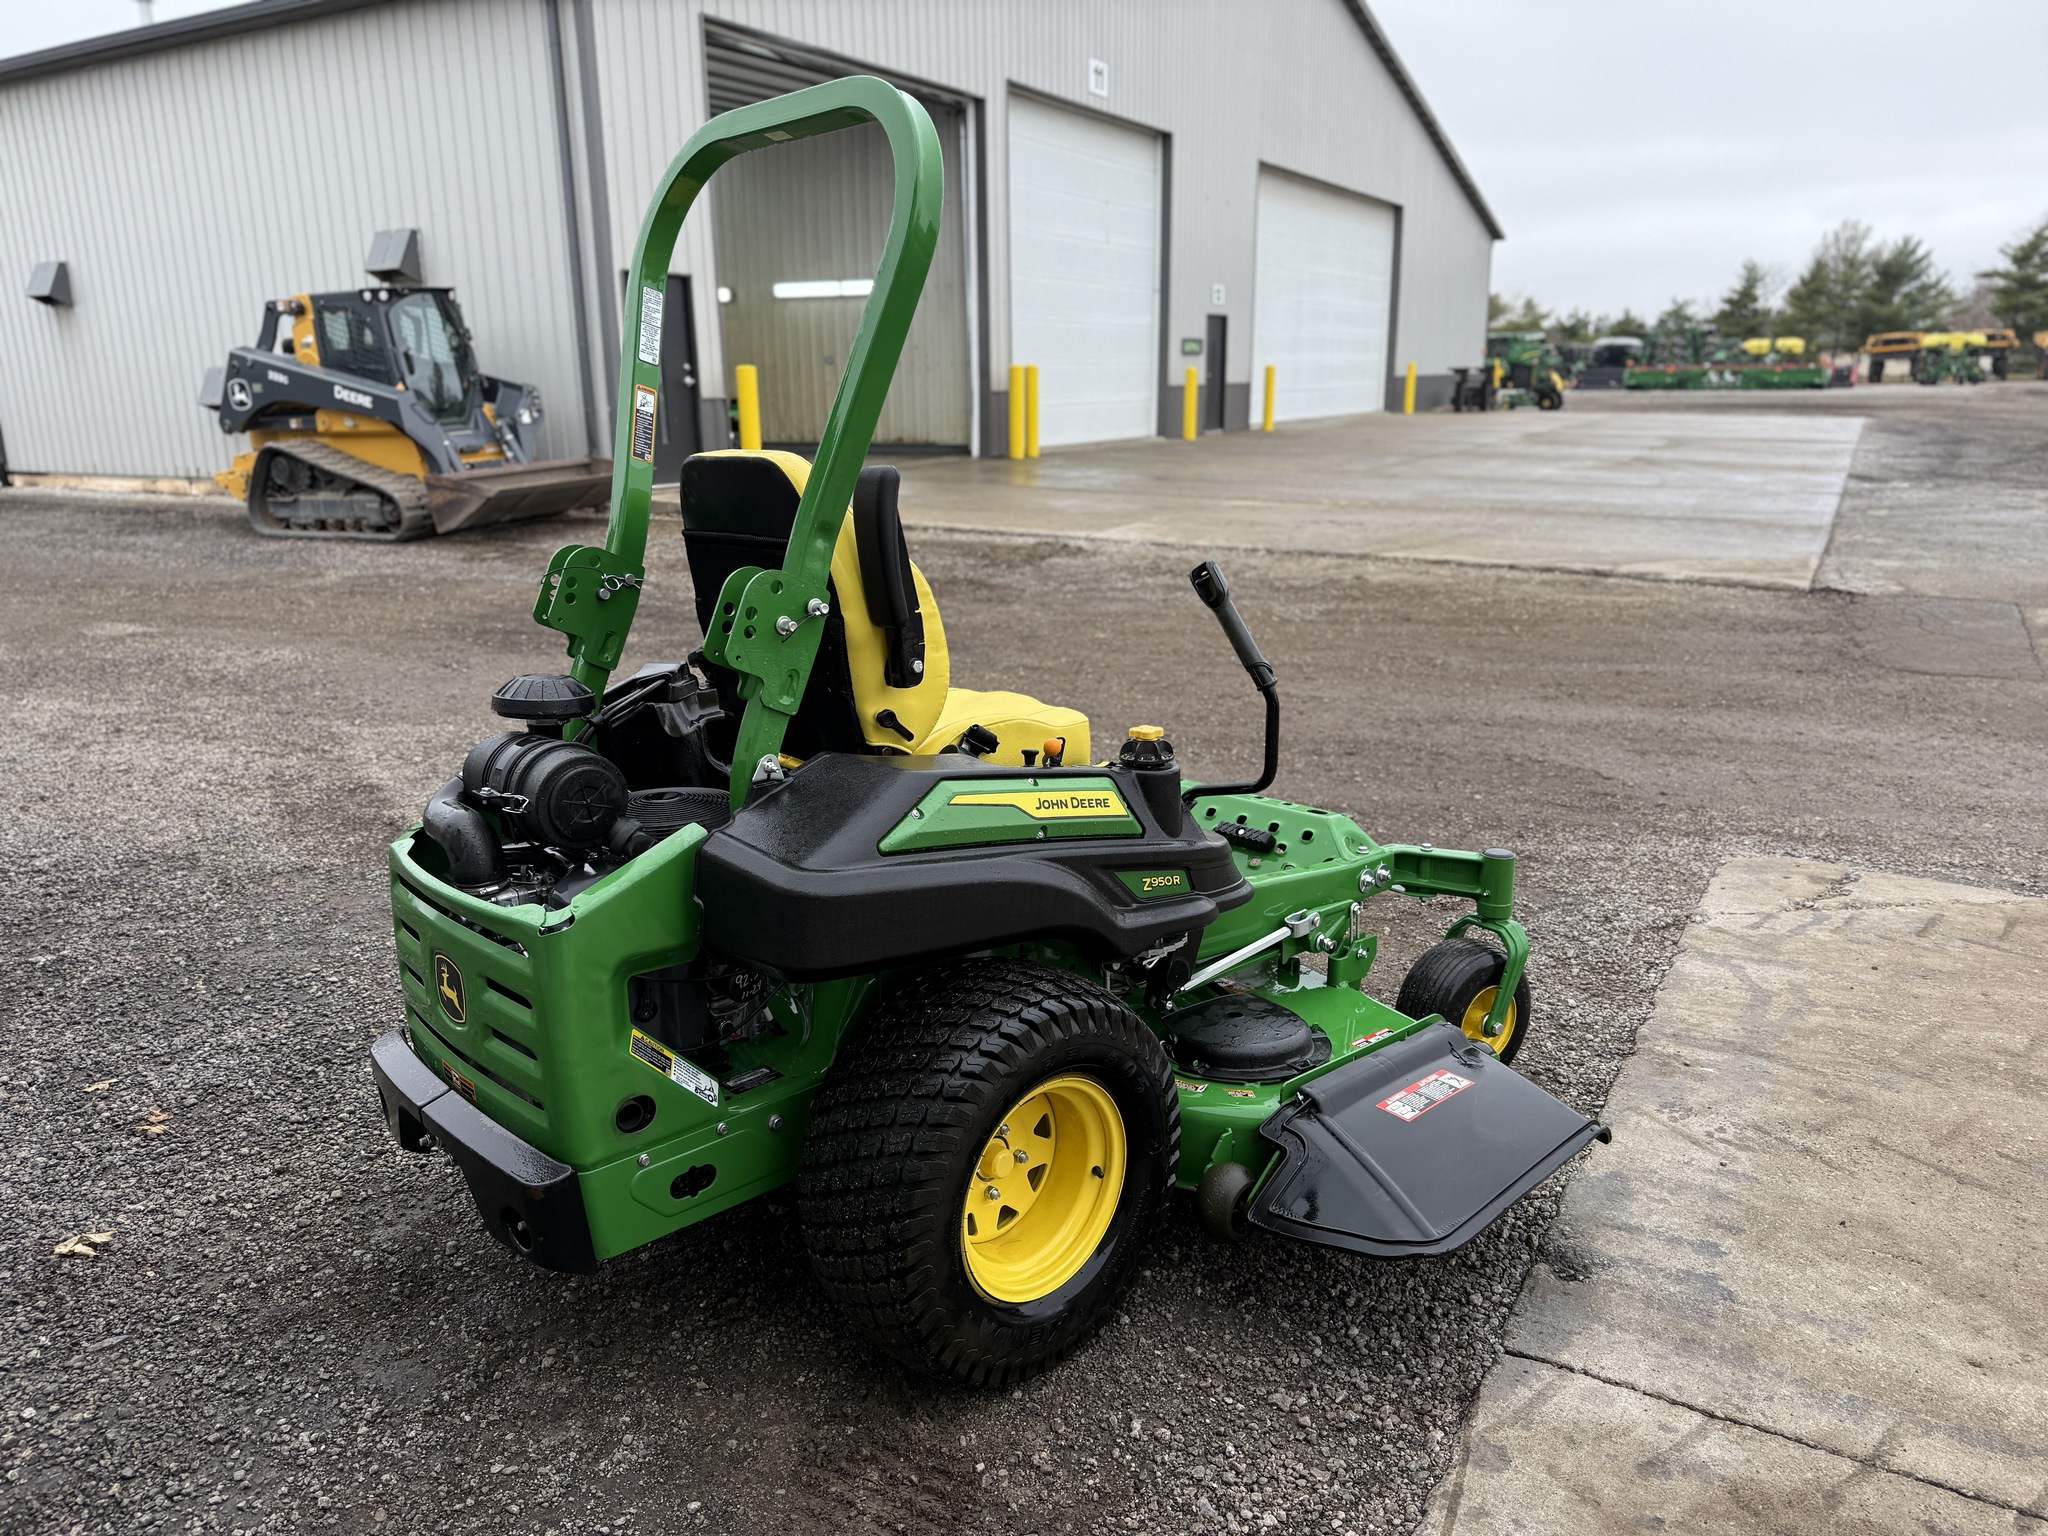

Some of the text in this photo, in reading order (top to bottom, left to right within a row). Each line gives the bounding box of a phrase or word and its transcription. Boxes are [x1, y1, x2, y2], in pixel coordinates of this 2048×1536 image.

[333, 384, 373, 409] DEERE
[1035, 796, 1110, 810] JOHN DEERE
[1142, 875, 1181, 891] Z950R
